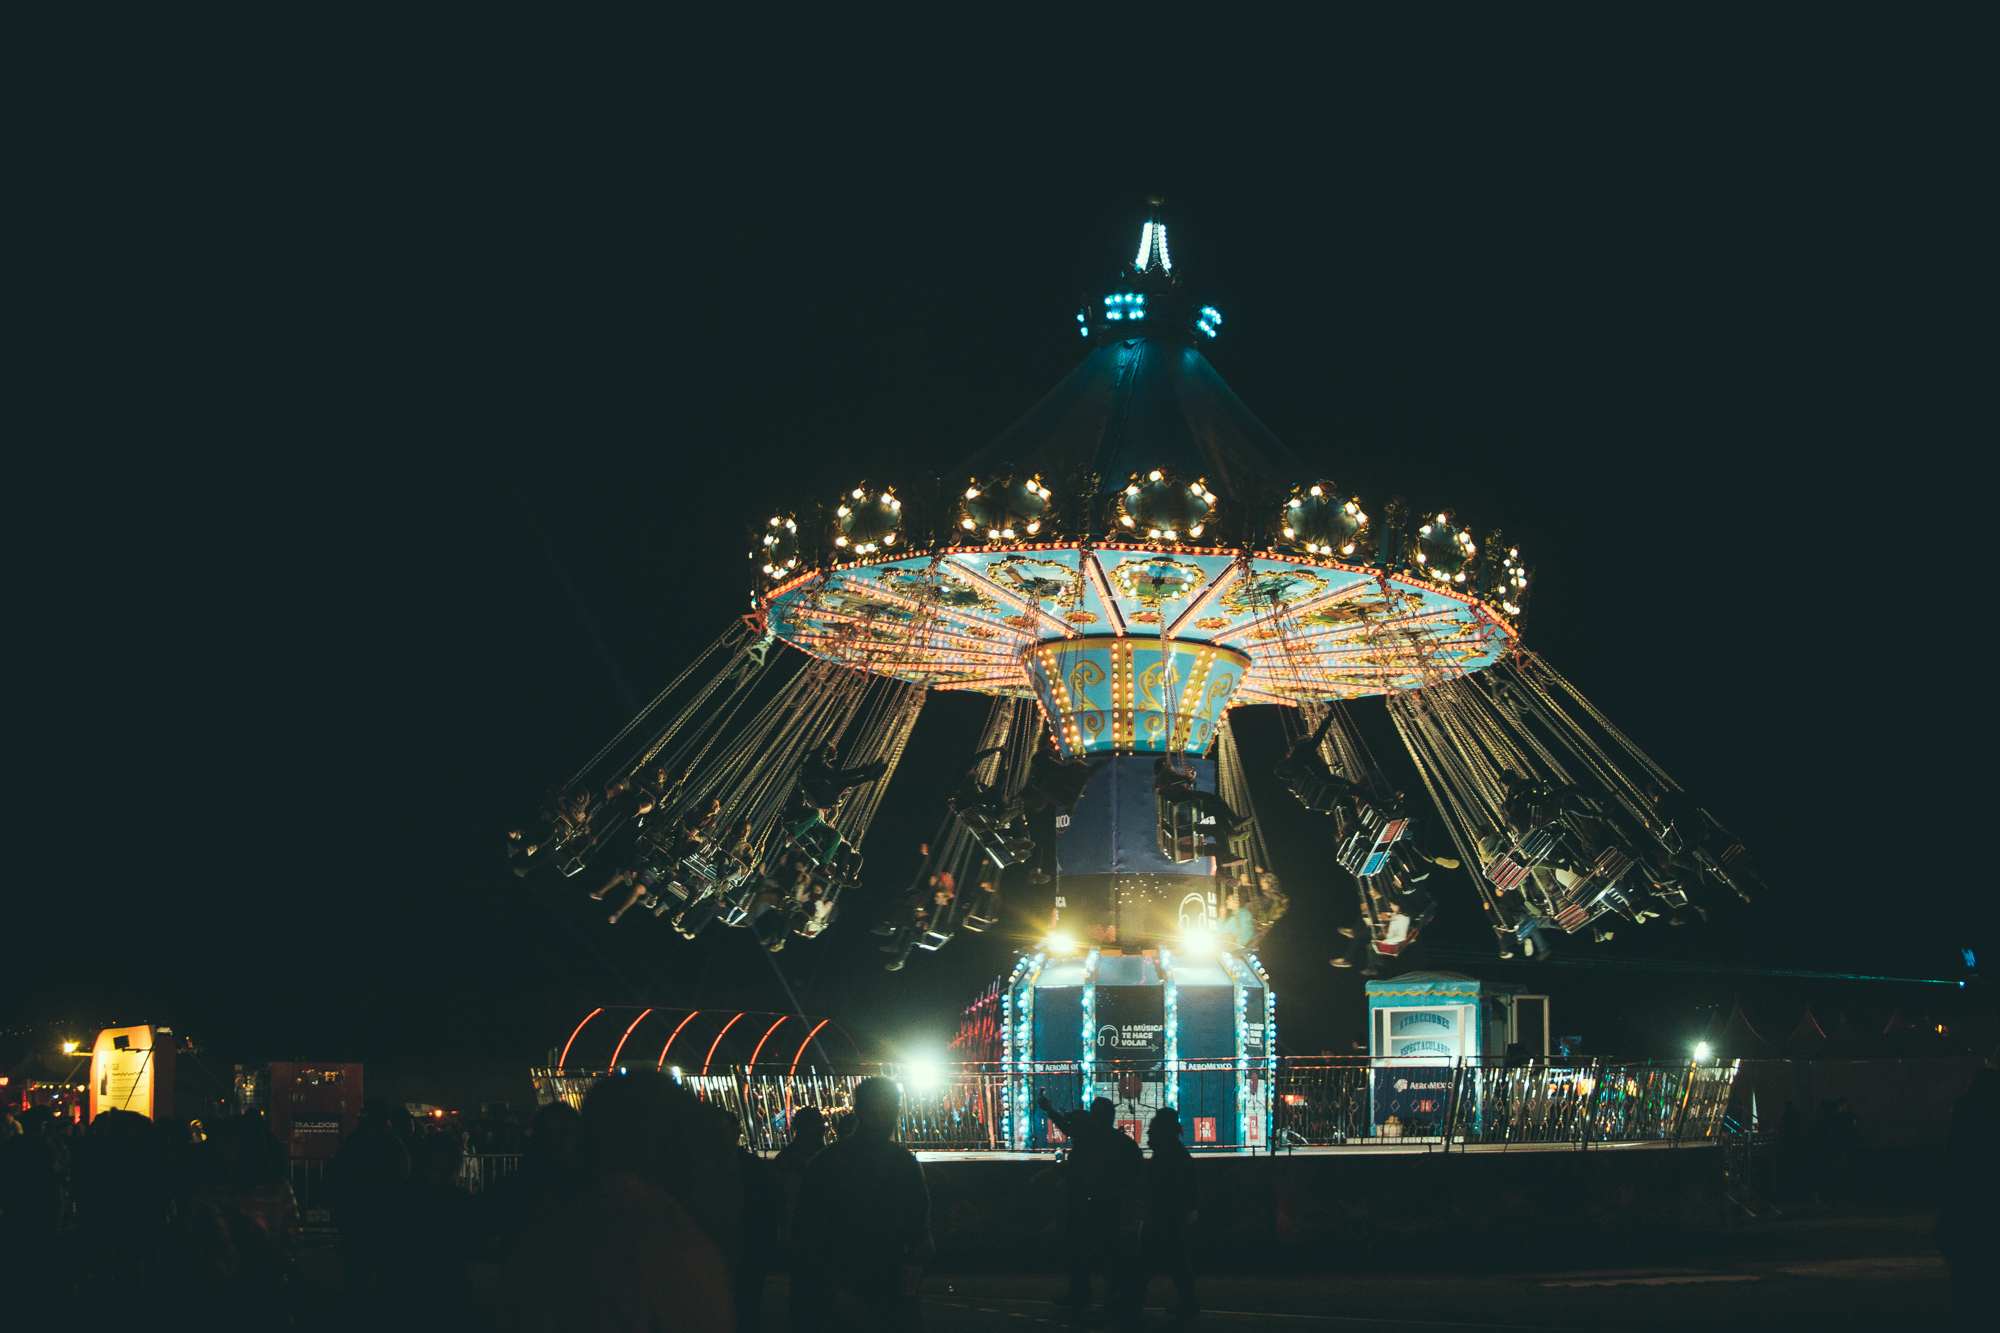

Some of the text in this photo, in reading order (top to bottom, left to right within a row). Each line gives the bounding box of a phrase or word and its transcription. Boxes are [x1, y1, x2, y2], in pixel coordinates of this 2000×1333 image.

[1400, 1013, 1450, 1030] ATRACCIONES
[1133, 1024, 1164, 1032] MÚSICA
[1188, 1062, 1233, 1070] AEROMEXICO
